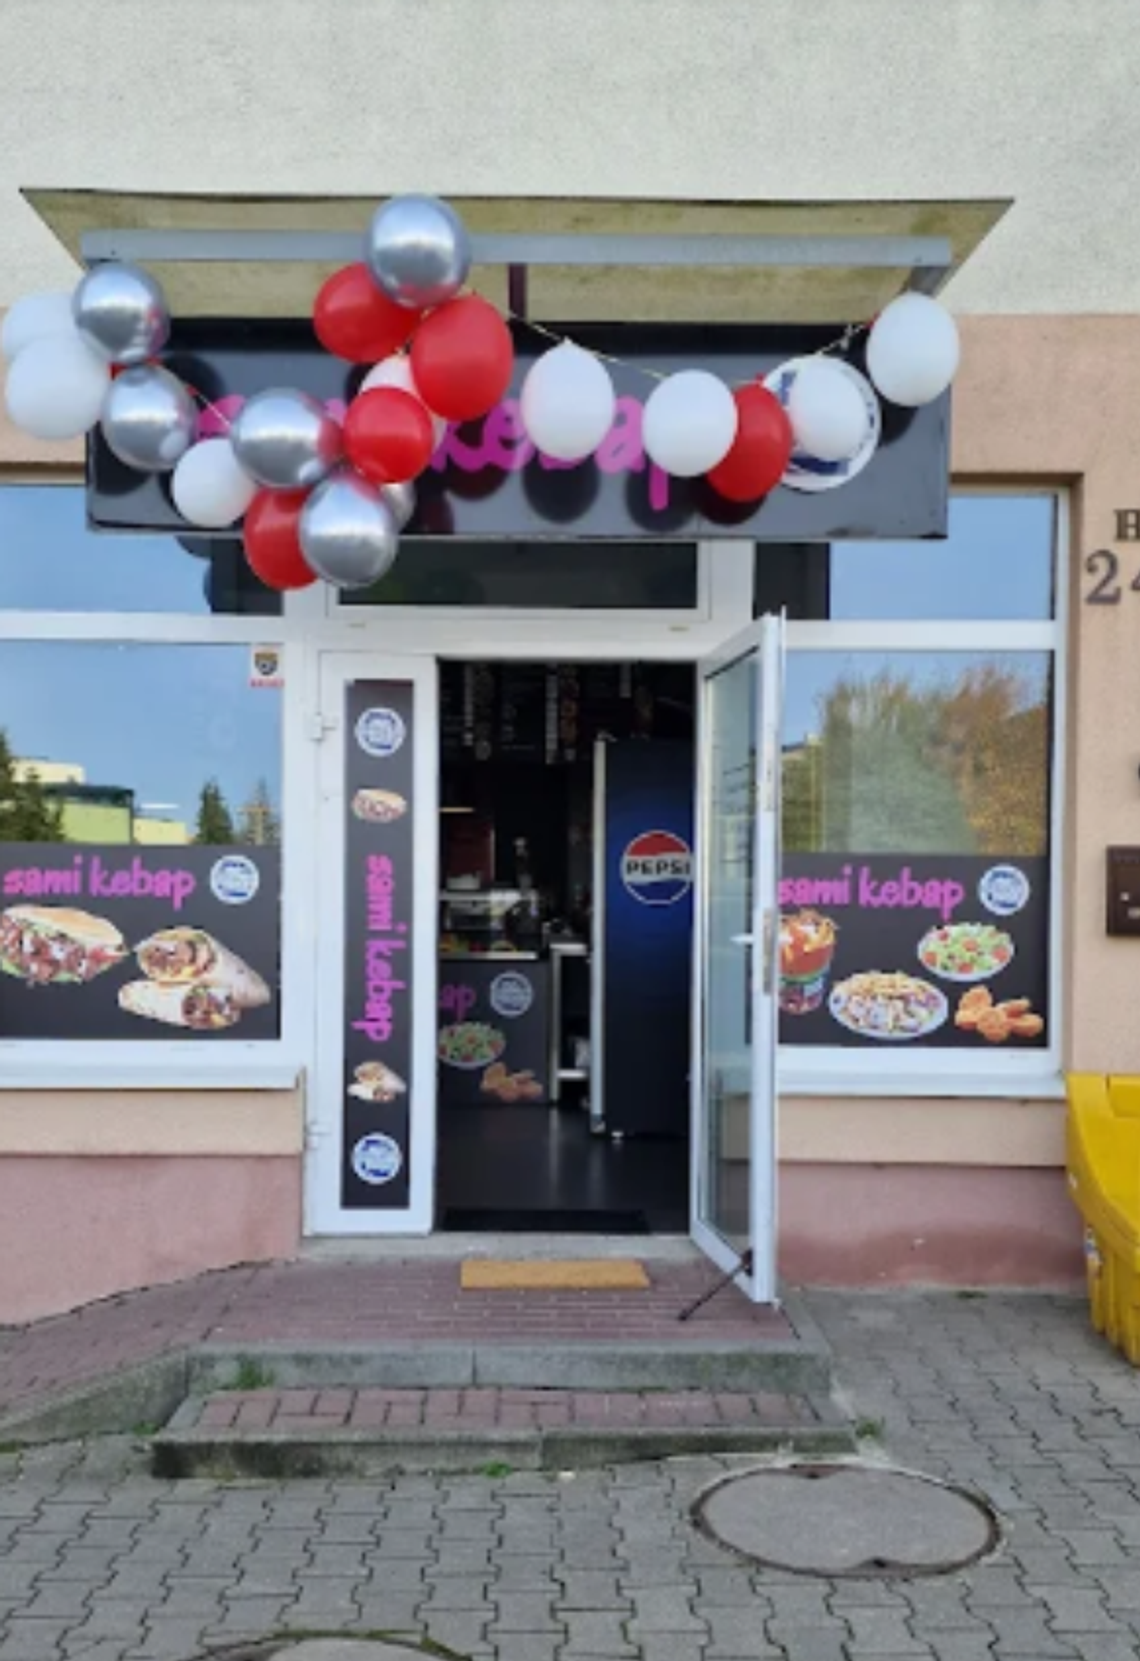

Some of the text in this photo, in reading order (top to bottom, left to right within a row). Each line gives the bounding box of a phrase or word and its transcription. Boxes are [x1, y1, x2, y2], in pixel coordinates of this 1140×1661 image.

[2, 854, 83, 898] sami
[87, 855, 195, 911] kebap
[626, 859, 691, 876] PEPSI
[778, 865, 853, 908] sami
[857, 866, 965, 923] kebap
[351, 854, 408, 1044] sami kebap
